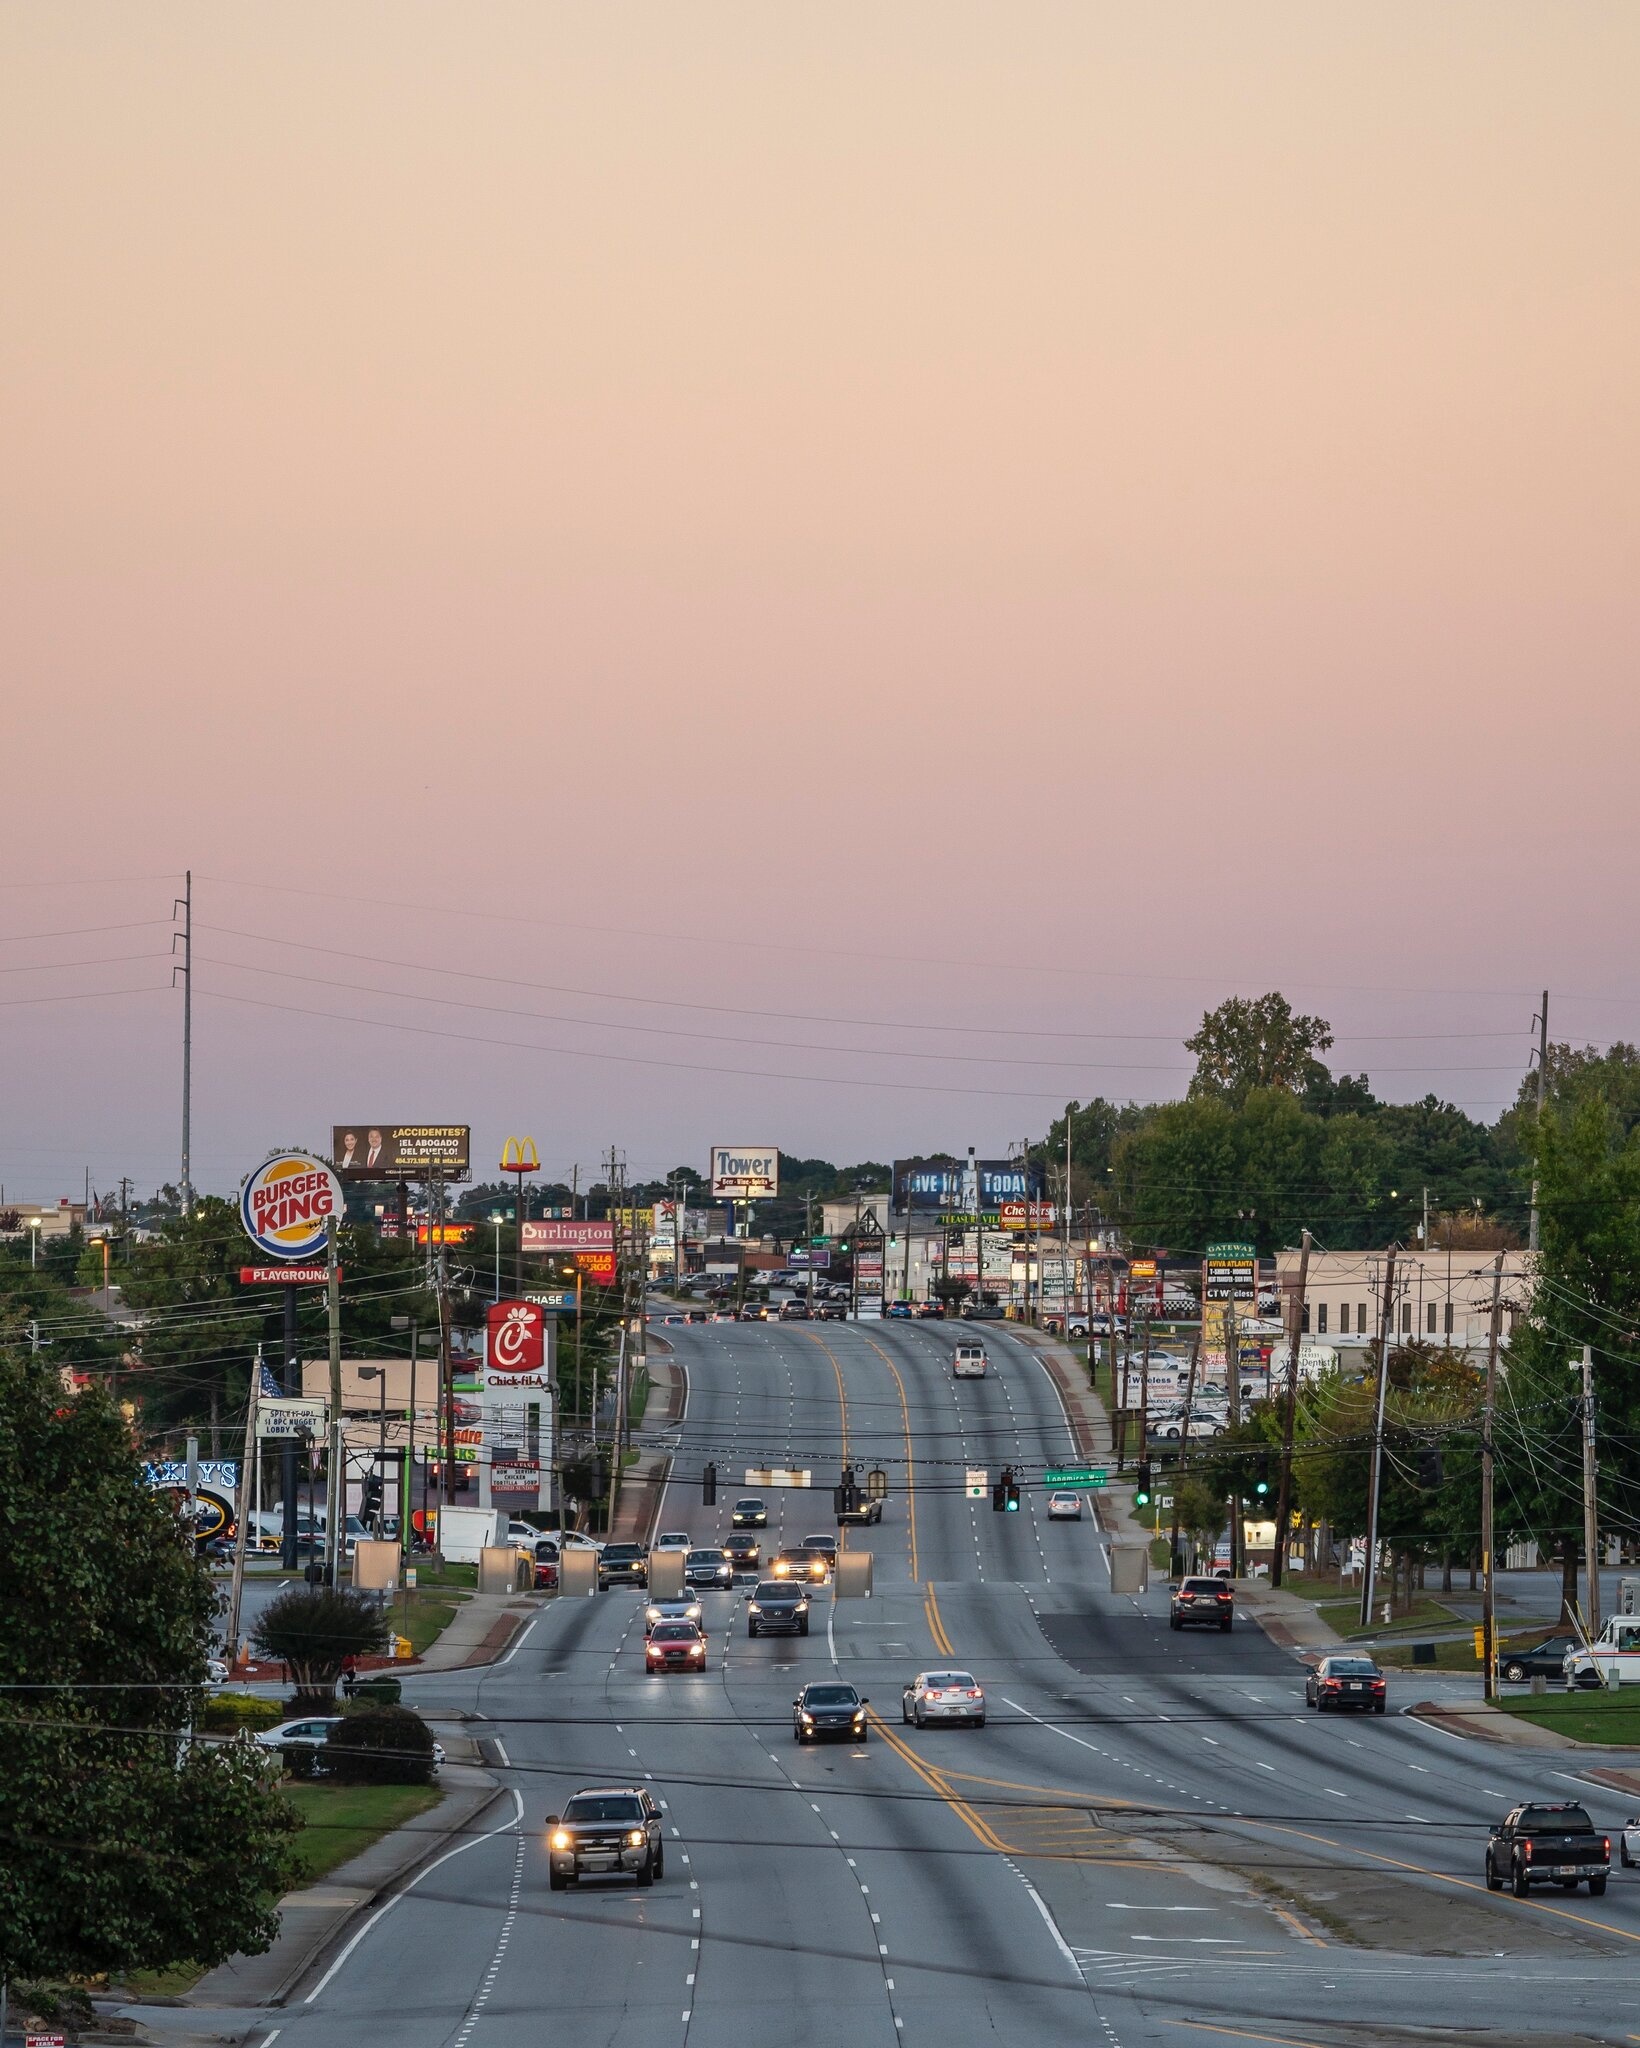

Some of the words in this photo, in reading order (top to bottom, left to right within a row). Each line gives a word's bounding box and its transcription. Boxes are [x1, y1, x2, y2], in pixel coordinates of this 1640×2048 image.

[392, 1128, 466, 1139] ¿ACCIDENTES?
[399, 1139, 414, 1147] ¡EL
[415, 1139, 459, 1147] ABOGADO
[400, 1148, 418, 1156] DEL
[717, 1152, 772, 1175] Tower
[254, 1172, 330, 1210] BURGER
[257, 1190, 332, 1237] KING
[1003, 1205, 1051, 1216] Chekrs
[942, 1215, 981, 1223] TEASUR
[522, 1223, 612, 1243] Burlington
[253, 1271, 330, 1280] PLAYGROUND
[1220, 1289, 1254, 1298] Weless
[526, 1296, 562, 1304] CHASE
[1302, 1359, 1331, 1367] Dentist
[488, 1375, 543, 1386] Chick-fil-A
[1047, 1476, 1086, 1485] Longmire
[1088, 1474, 1105, 1484] Way
